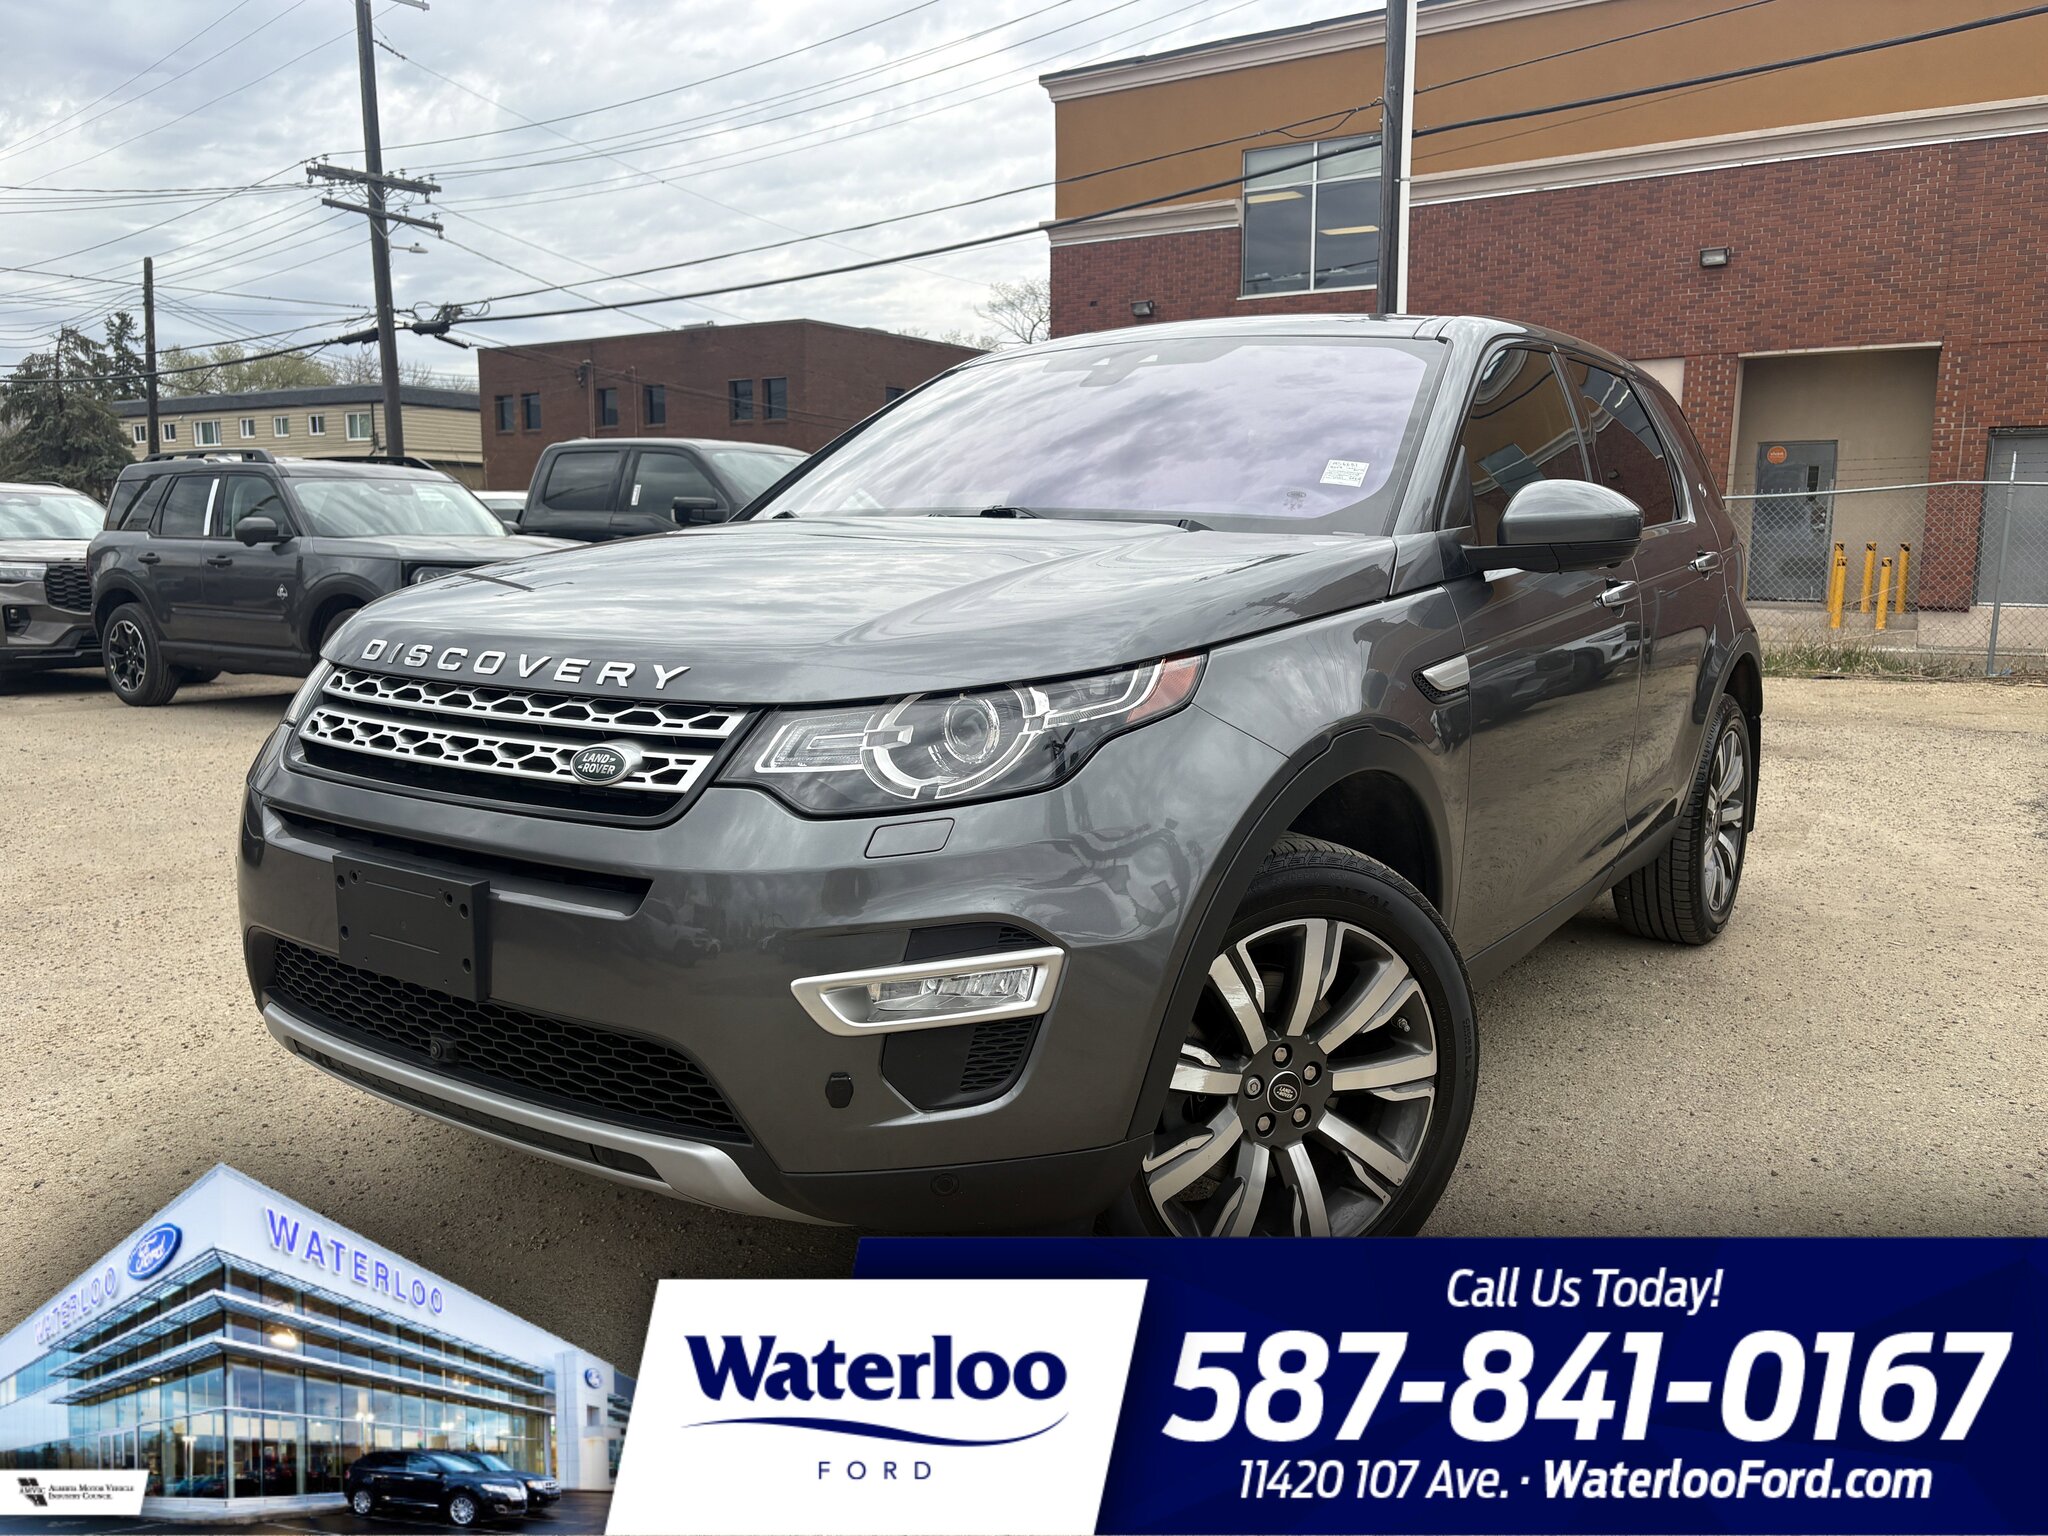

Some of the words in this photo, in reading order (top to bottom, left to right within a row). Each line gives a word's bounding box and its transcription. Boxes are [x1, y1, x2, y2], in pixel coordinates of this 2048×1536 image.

[361, 638, 692, 690] DISCOVERY
[582, 752, 611, 764] LAND
[581, 762, 616, 775] ROVER
